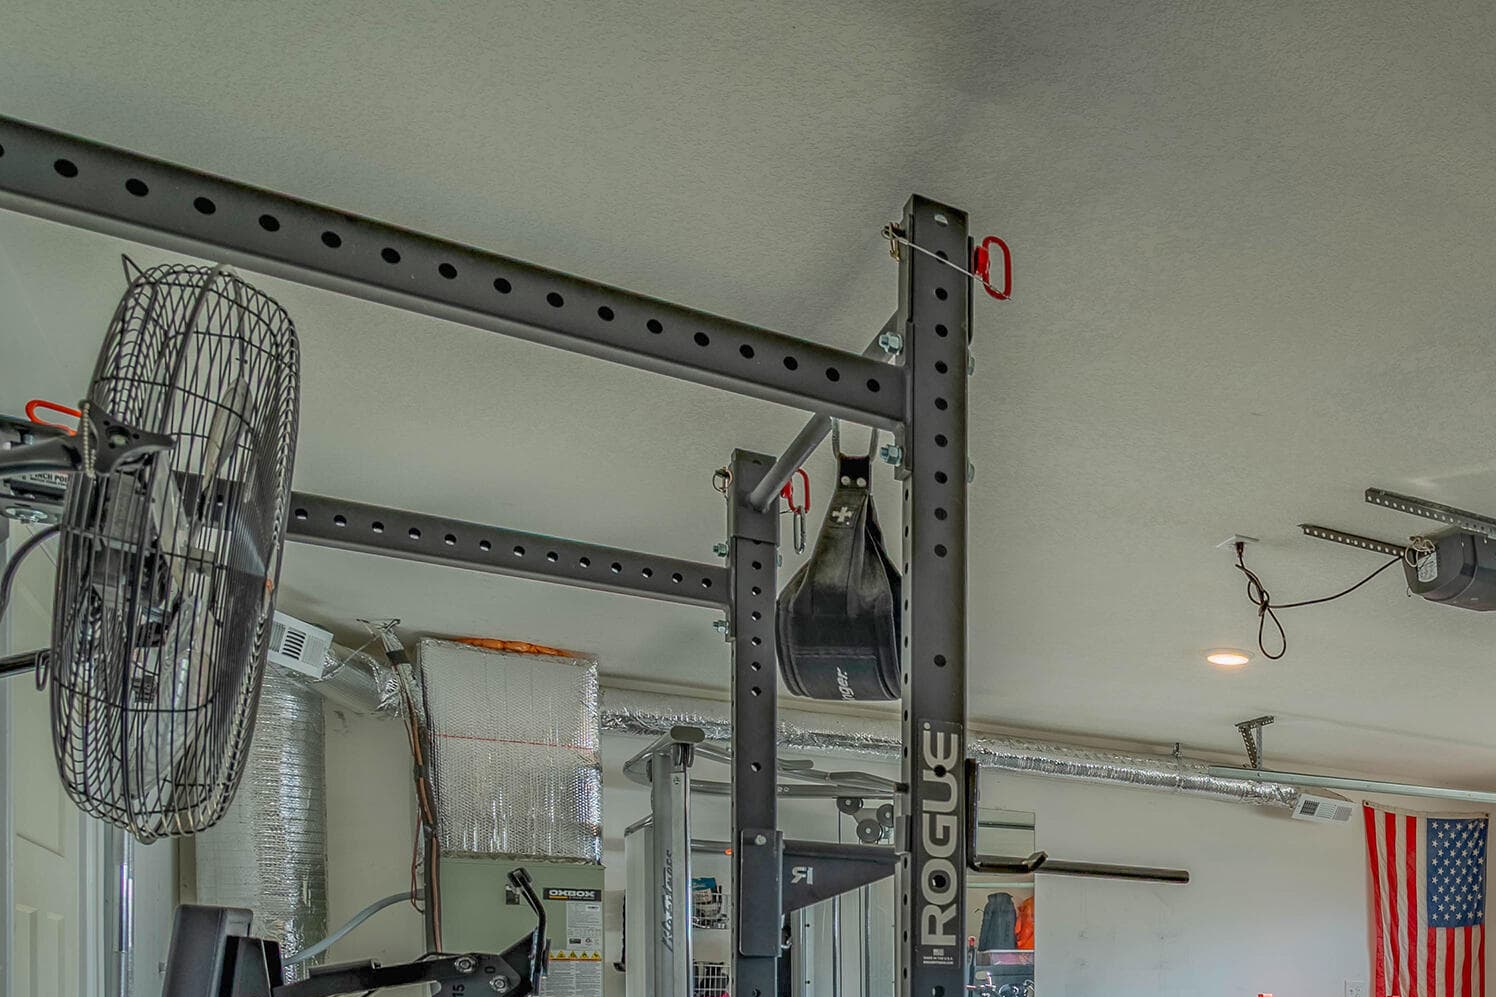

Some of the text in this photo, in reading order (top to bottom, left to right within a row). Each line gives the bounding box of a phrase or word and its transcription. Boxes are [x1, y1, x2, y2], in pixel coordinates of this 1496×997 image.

[921, 730, 959, 946] ROGUE
[548, 890, 596, 898] OXBOX
[484, 966, 496, 974] 0
